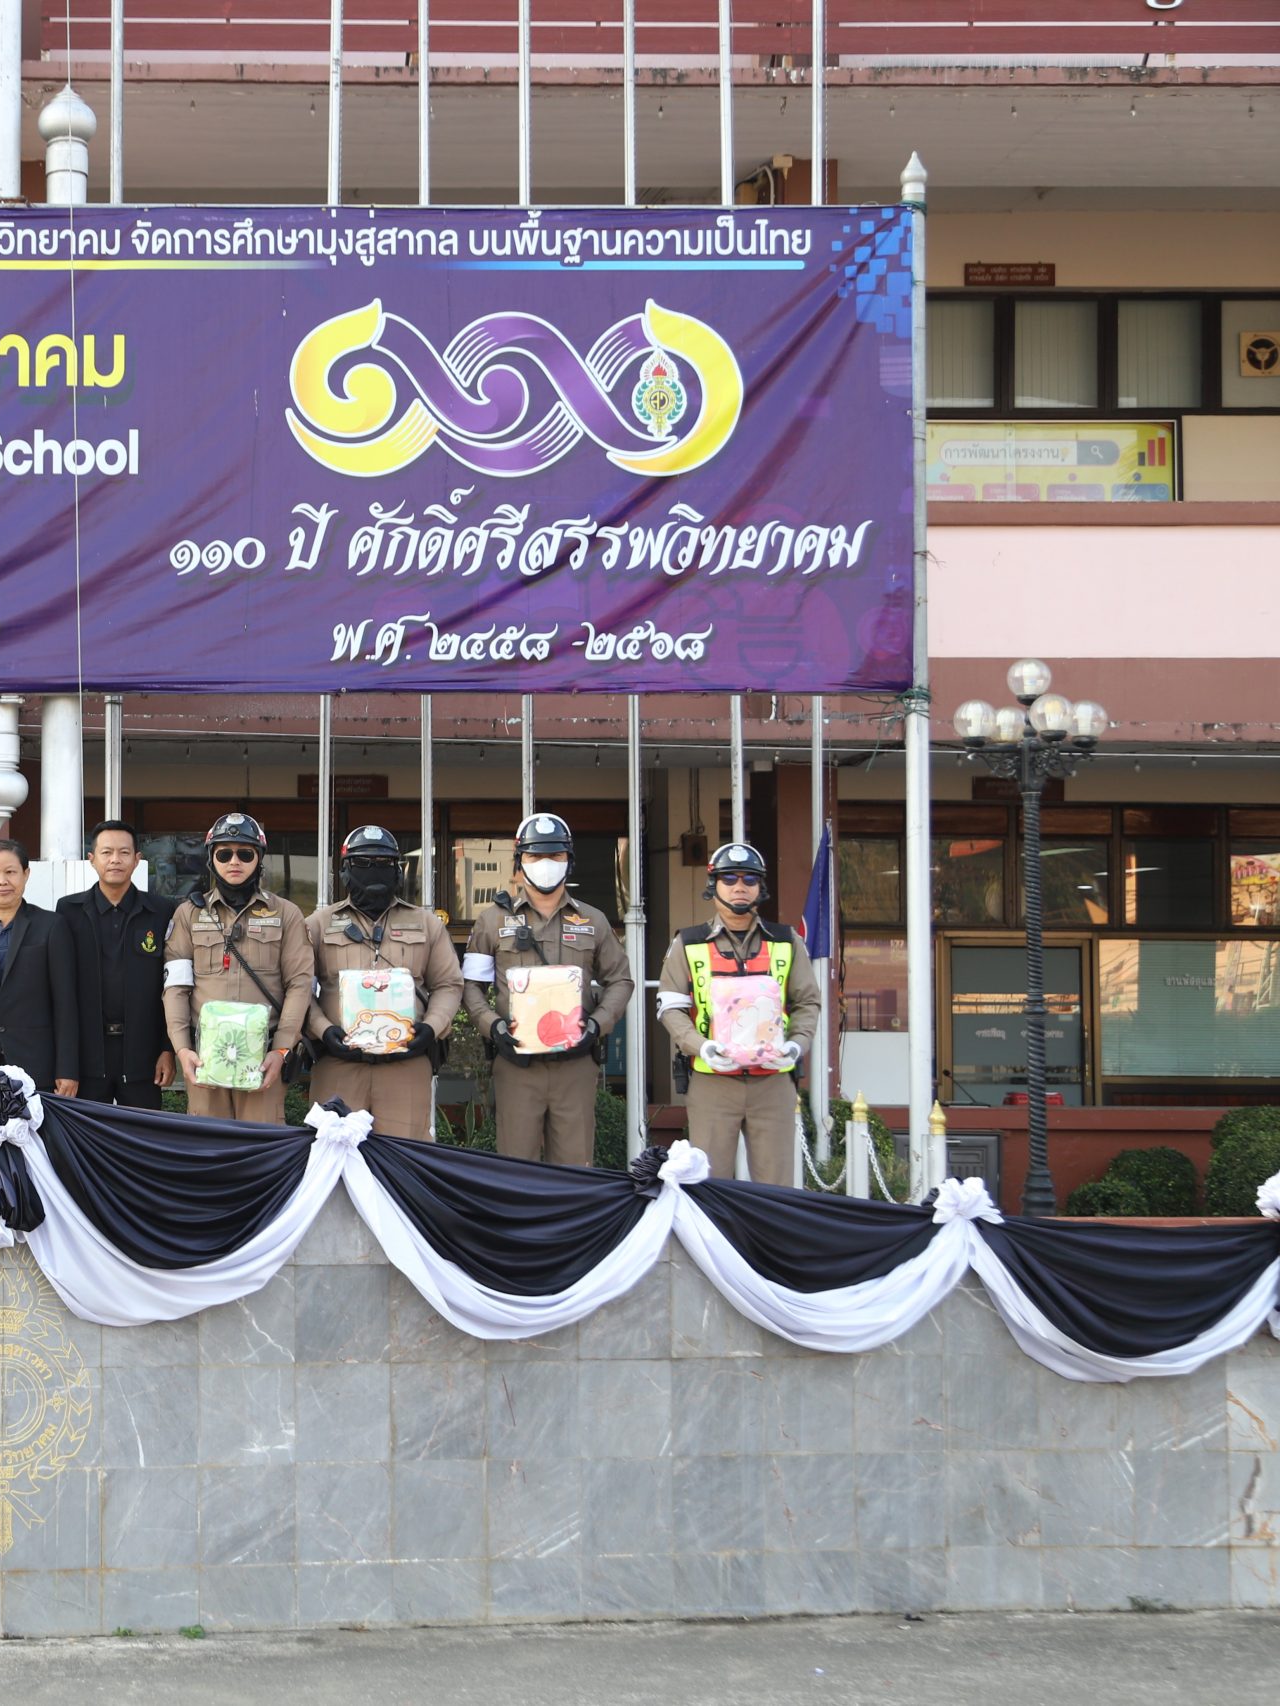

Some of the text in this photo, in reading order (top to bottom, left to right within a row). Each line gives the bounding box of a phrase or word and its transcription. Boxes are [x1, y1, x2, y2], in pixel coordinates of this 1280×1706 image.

[130, 209, 458, 266] จัดการศึกษามุ่งสู่สากล
[469, 211, 812, 264] บนพื้นฐานความเป็นไทย
[170, 485, 873, 576] ๑๑๐ ปี ศักดิ์ศรีสรรพวิทยาคม
[330, 611, 431, 667] พ.ศ.
